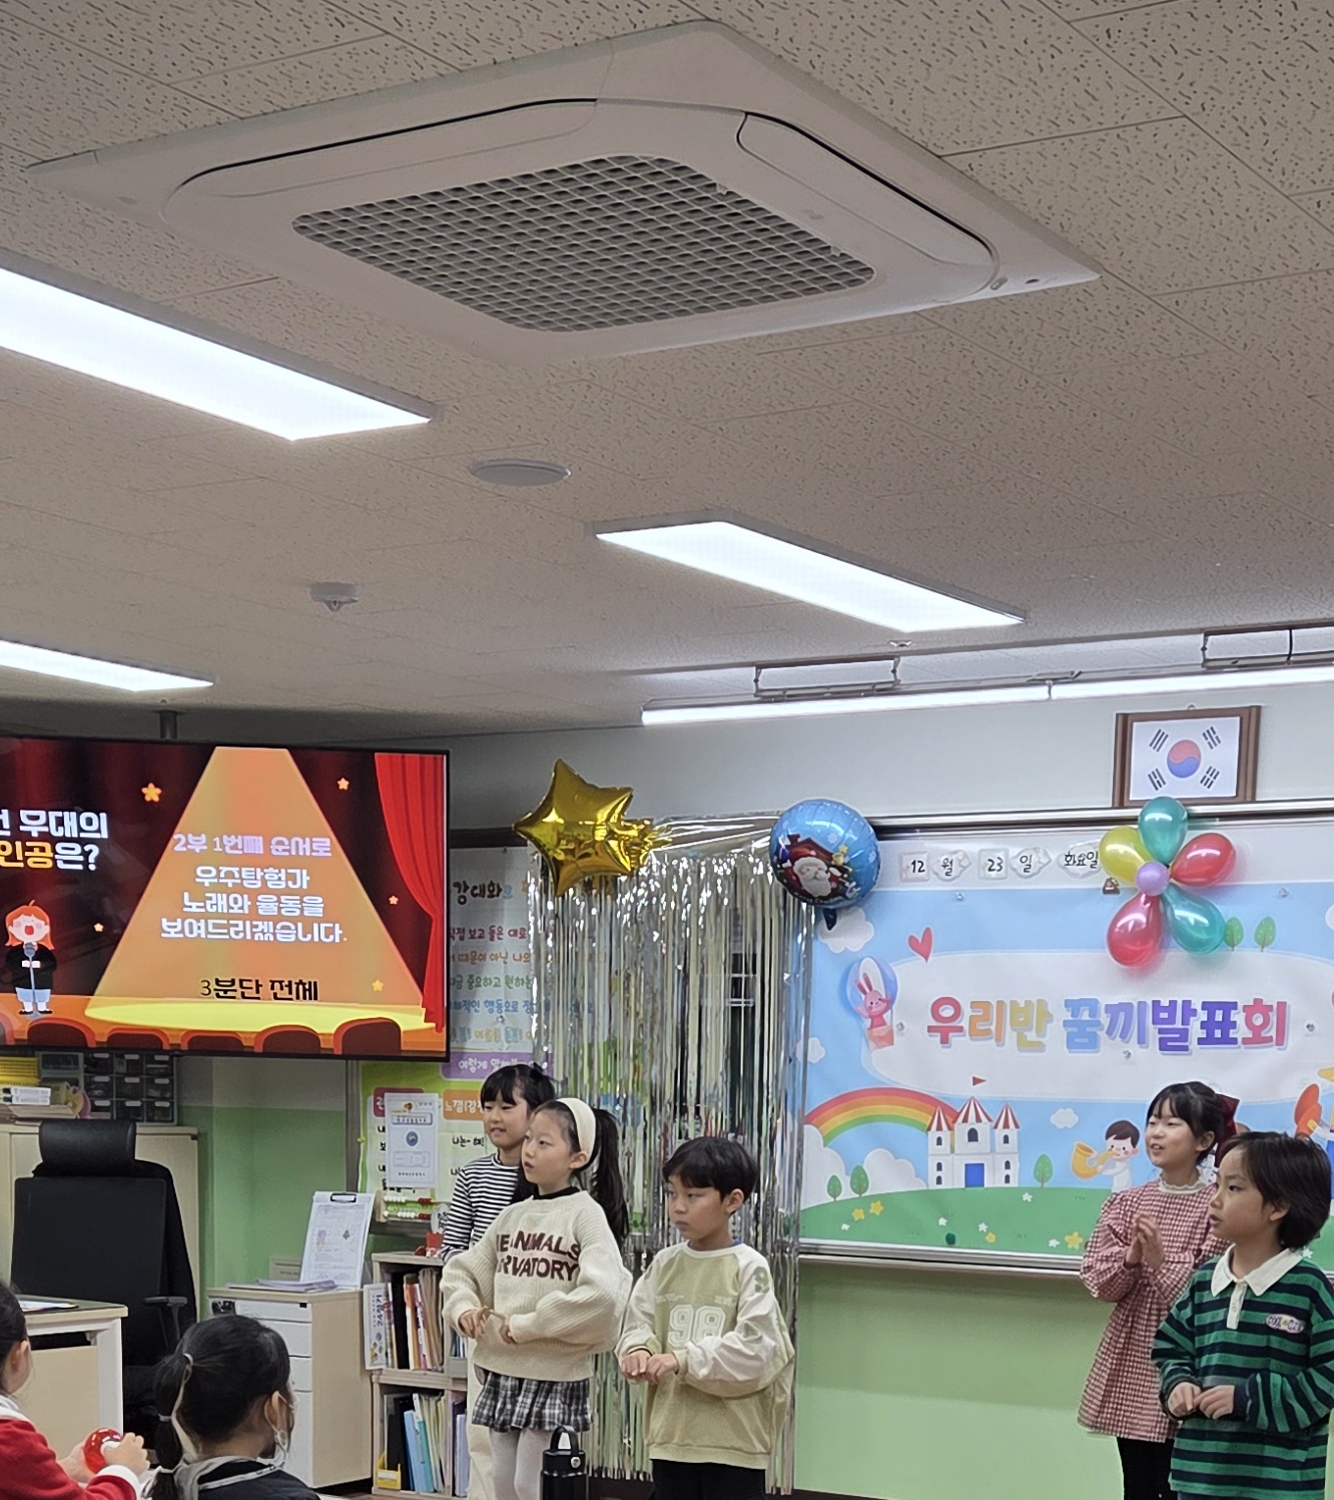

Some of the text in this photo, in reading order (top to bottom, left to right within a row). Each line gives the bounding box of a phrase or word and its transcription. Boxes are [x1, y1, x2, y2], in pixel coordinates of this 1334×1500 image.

[19, 809, 109, 839] 무대의
[173, 834, 332, 857] 2부 1번째 순서로
[911, 850, 1099, 876] 12 월 23 일 화요일
[195, 866, 310, 889] 우주탐험가
[183, 892, 324, 917] 노래와 율동을
[161, 918, 348, 942] 보여드리겠습니다.
[469, 928, 485, 939] 보고
[489, 925, 504, 941] 들은
[508, 927, 527, 939] 대로
[458, 951, 486, 964] 때문이
[489, 951, 508, 964] 아닌
[200, 978, 318, 1001] 3분단 전체
[467, 975, 501, 990] 중요하고
[484, 999, 519, 1014] 행동으로
[926, 996, 1289, 1054] 우리반 꿈끼발표회
[459, 1058, 487, 1073] 이렇게
